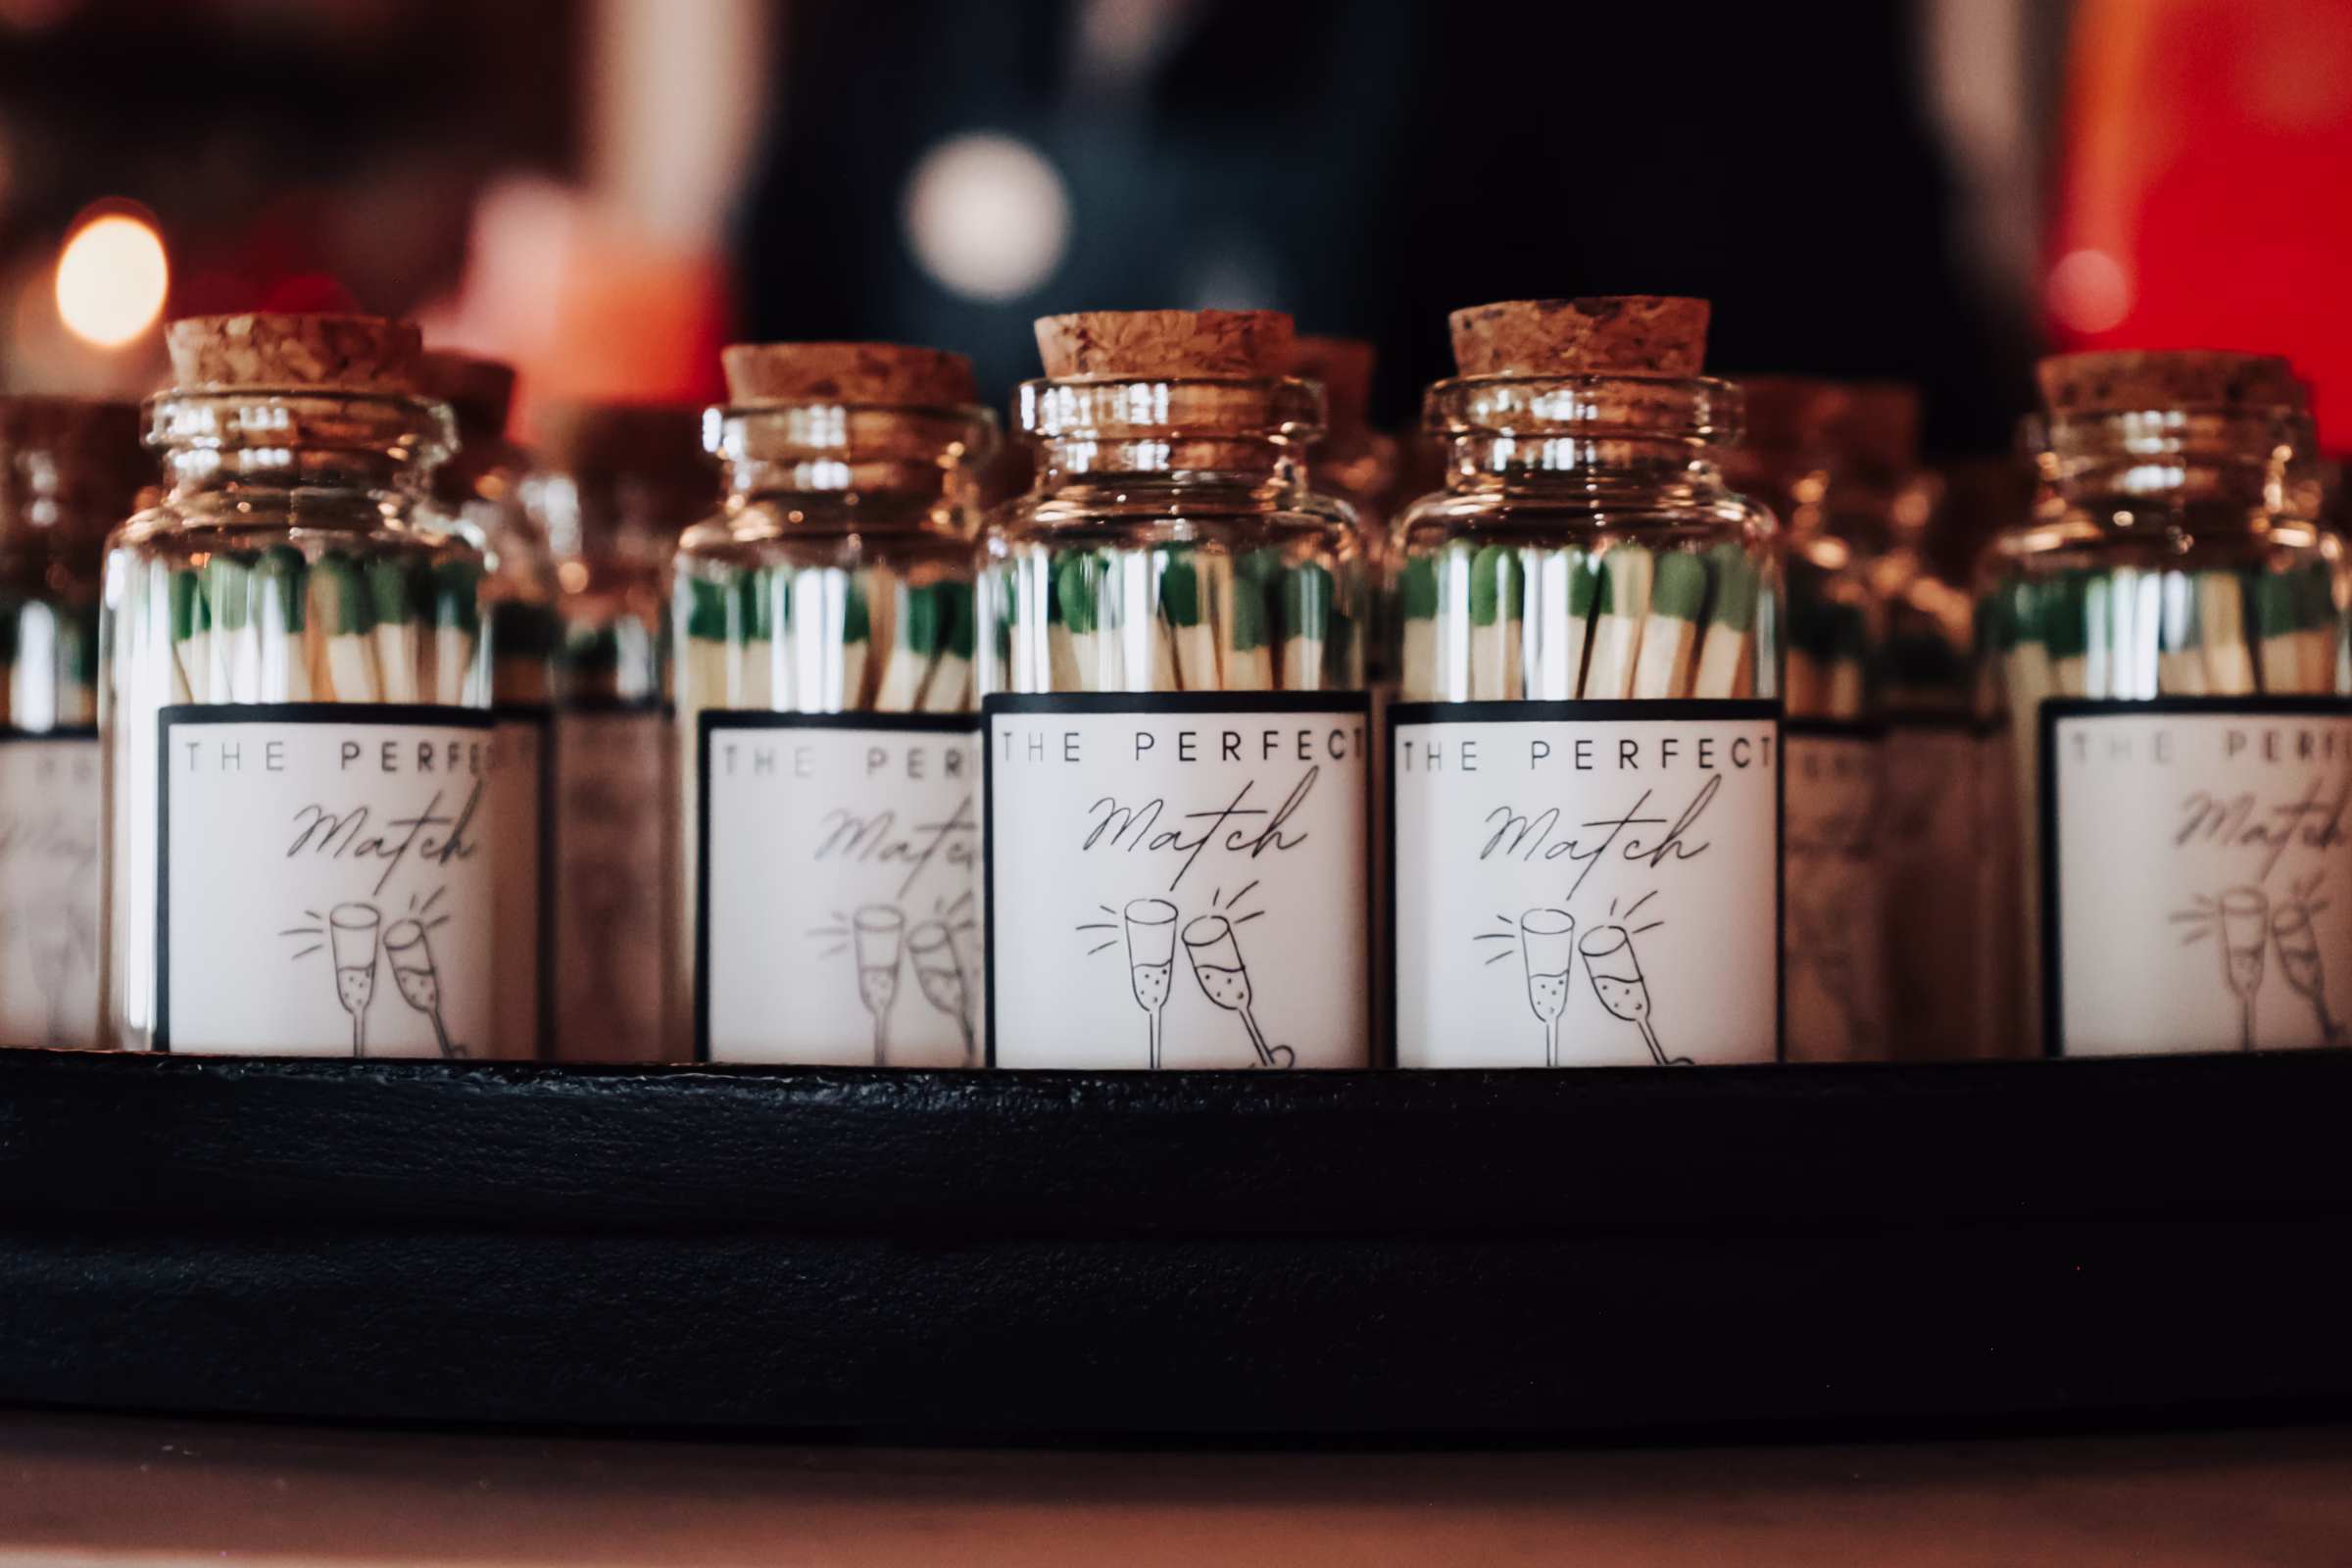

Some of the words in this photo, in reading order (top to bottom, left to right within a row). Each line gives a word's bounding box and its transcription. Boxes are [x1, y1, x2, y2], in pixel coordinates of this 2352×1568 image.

[184, 741, 285, 771] THE
[722, 744, 813, 778] THE
[1002, 731, 1080, 762] THE
[1135, 728, 1363, 762] PERFECT
[1403, 740, 1477, 771] THE
[1531, 736, 1771, 770] PERFECT
[285, 778, 483, 897] Match
[1082, 764, 1319, 892] Match
[1480, 773, 1722, 902] Match
